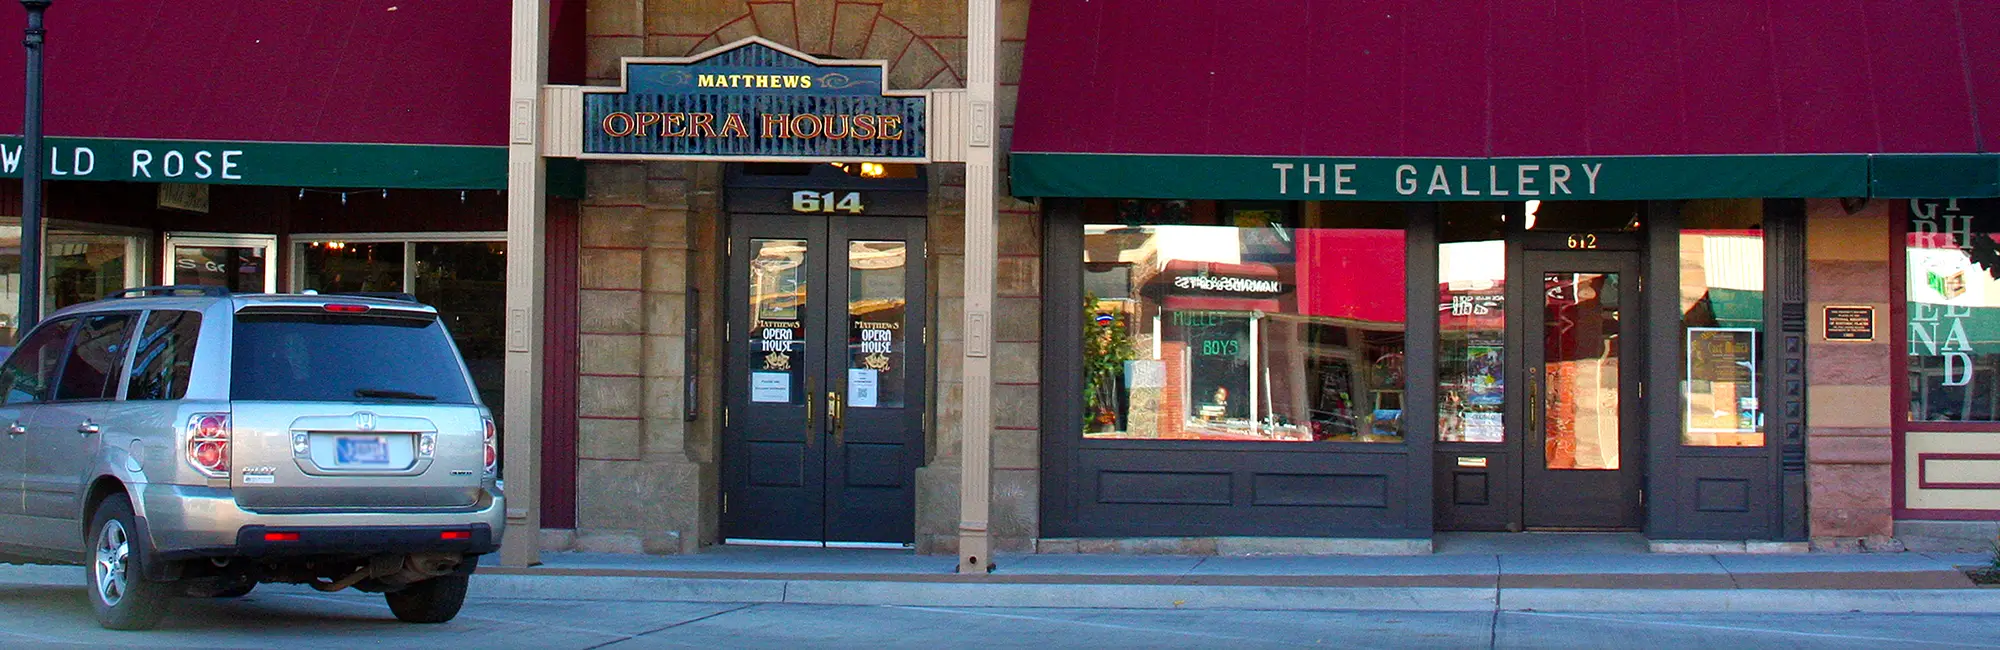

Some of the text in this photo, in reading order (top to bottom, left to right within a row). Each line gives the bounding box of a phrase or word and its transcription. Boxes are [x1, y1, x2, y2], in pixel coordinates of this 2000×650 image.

[698, 74, 812, 89] MATTHEWS
[602, 111, 903, 141] OPERA HOUSE
[0, 143, 243, 180] WLD ROSE
[1272, 163, 1602, 196] THE GALLERY
[792, 190, 864, 214] 614
[1567, 233, 1597, 249] 612
[762, 327, 793, 341] OPERA
[861, 329, 892, 342] OPERA
[762, 340, 793, 352] HOUSE
[861, 341, 892, 353] HOUSE
[1203, 339, 1239, 356] BOYS
